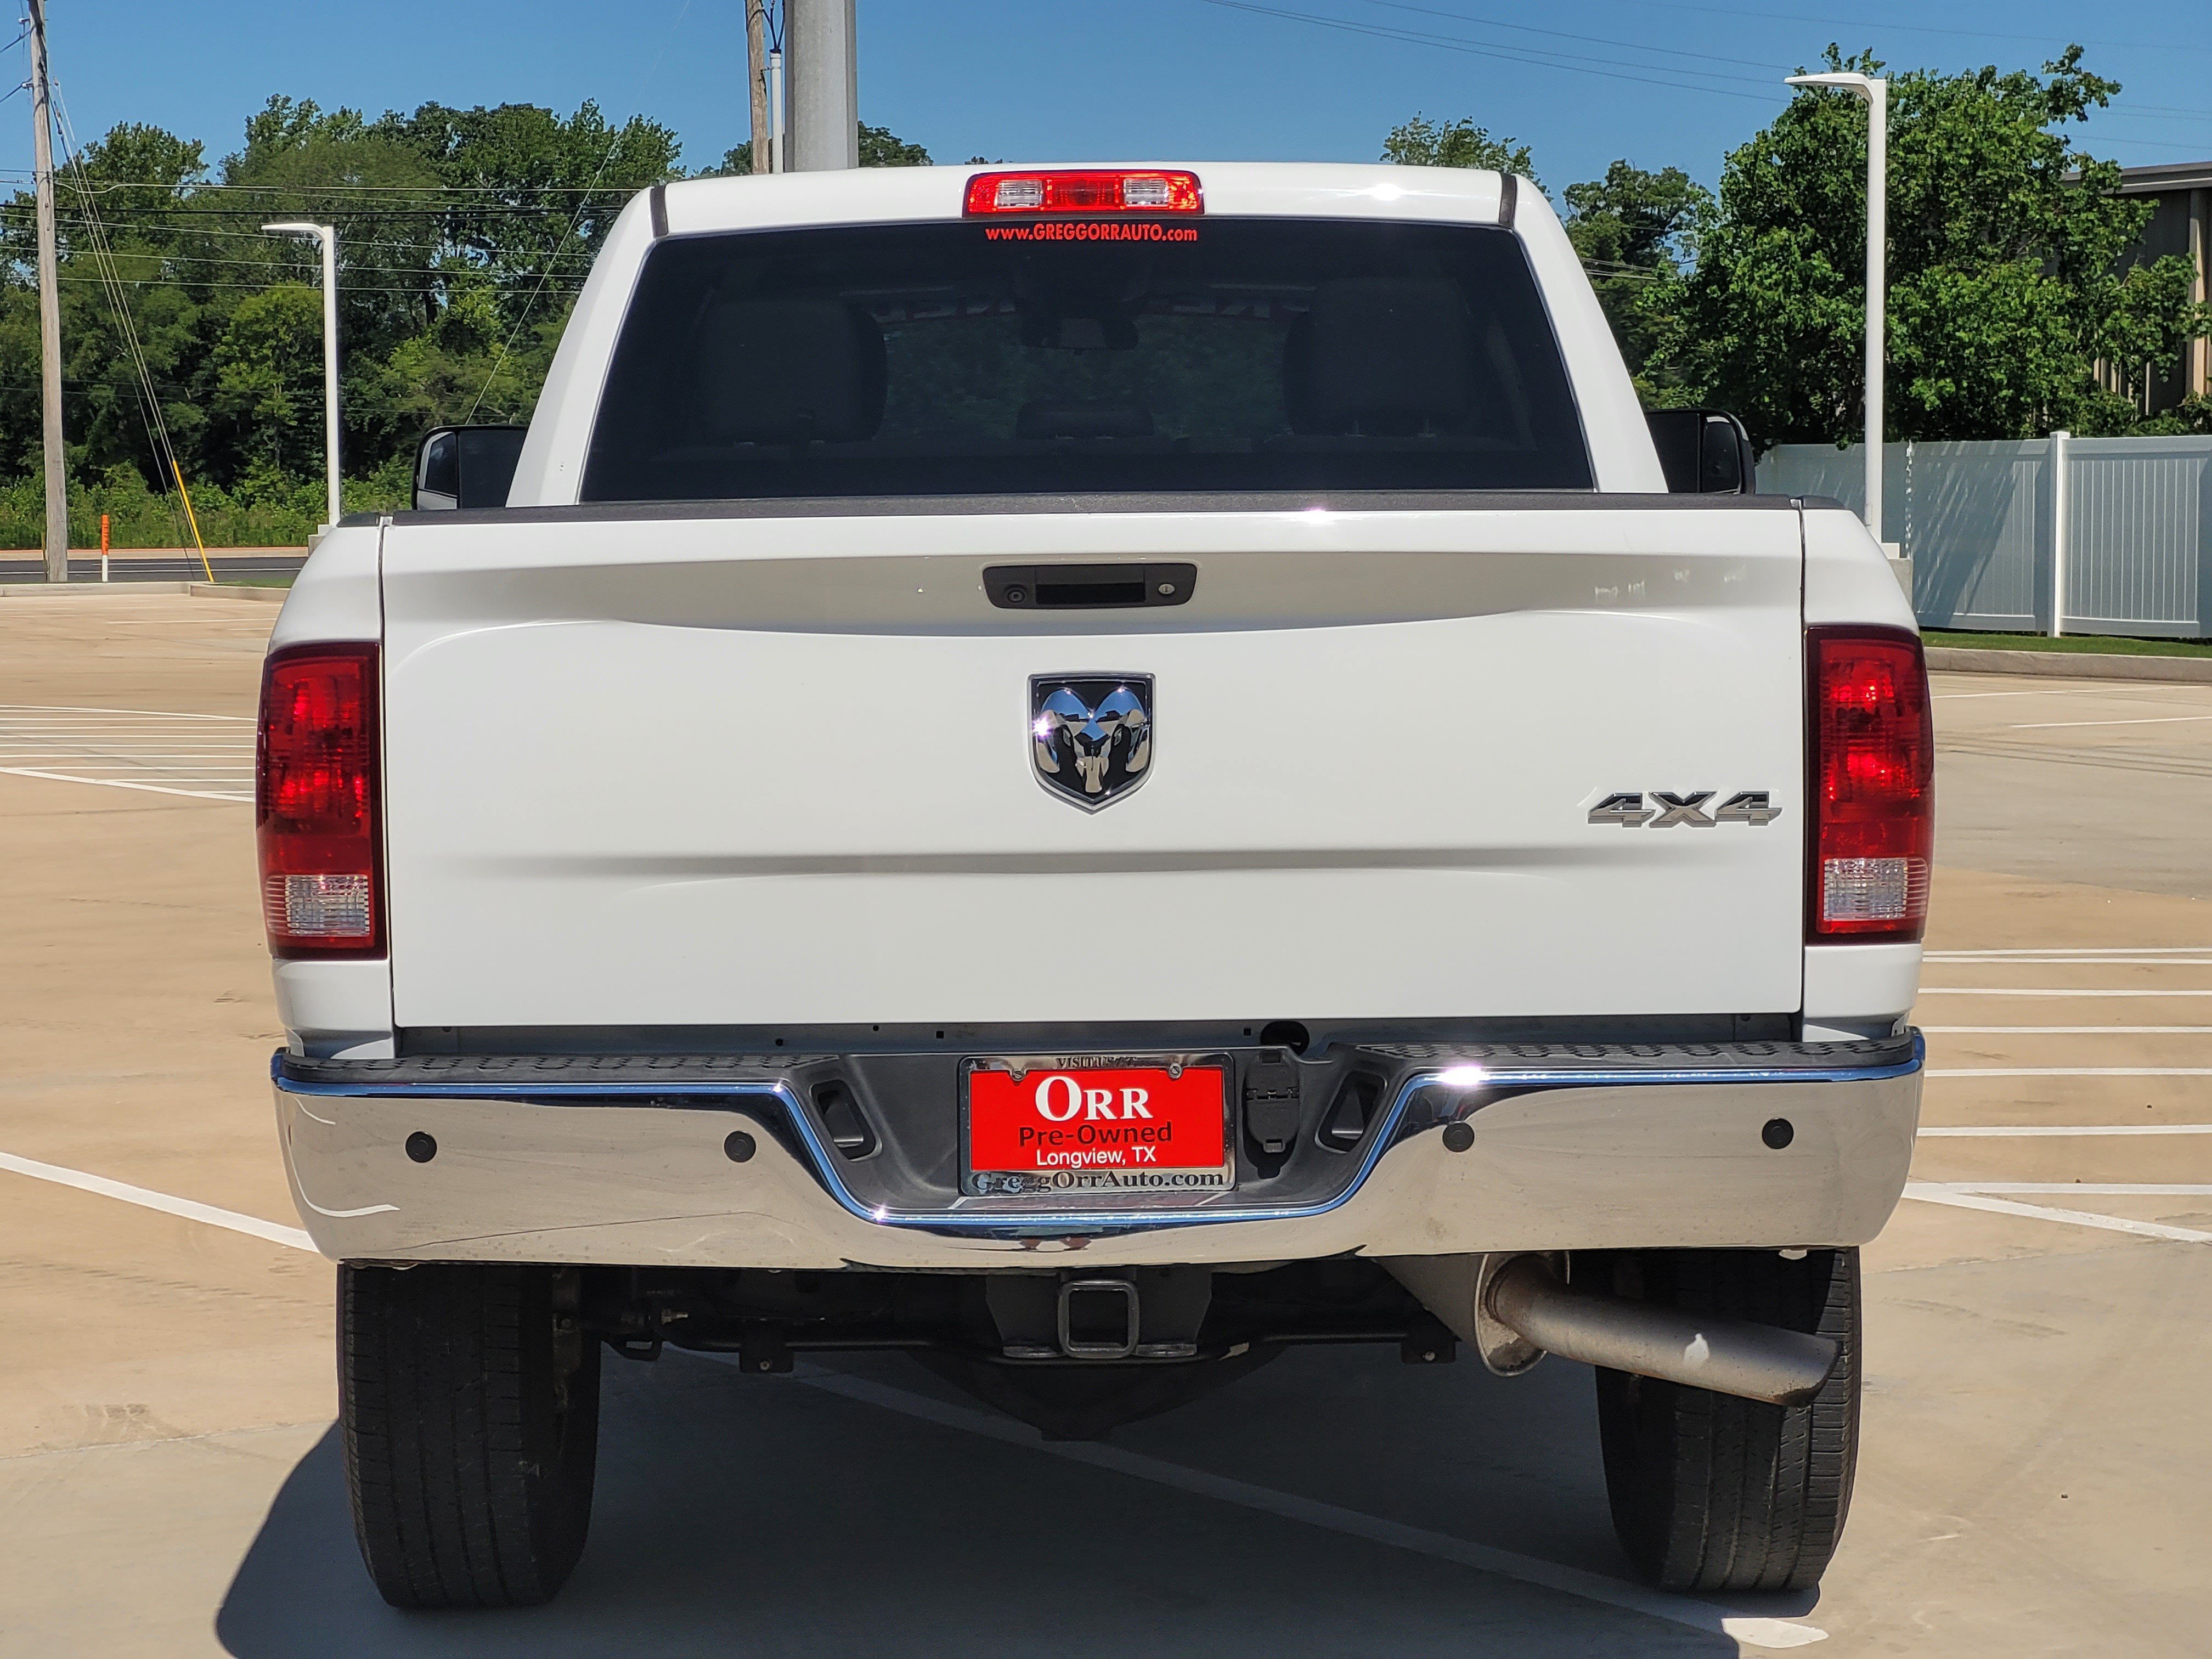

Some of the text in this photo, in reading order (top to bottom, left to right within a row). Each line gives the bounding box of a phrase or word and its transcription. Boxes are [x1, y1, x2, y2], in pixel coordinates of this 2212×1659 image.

[985, 223, 1198, 241] www.GREGGORRAUTO.com
[1588, 791, 1783, 828] 4X4
[1019, 1121, 1172, 1147] Pre-Owned
[1036, 1146, 1156, 1169] Longview, TX
[971, 1171, 1224, 1193] GreggOrrAuto.com
